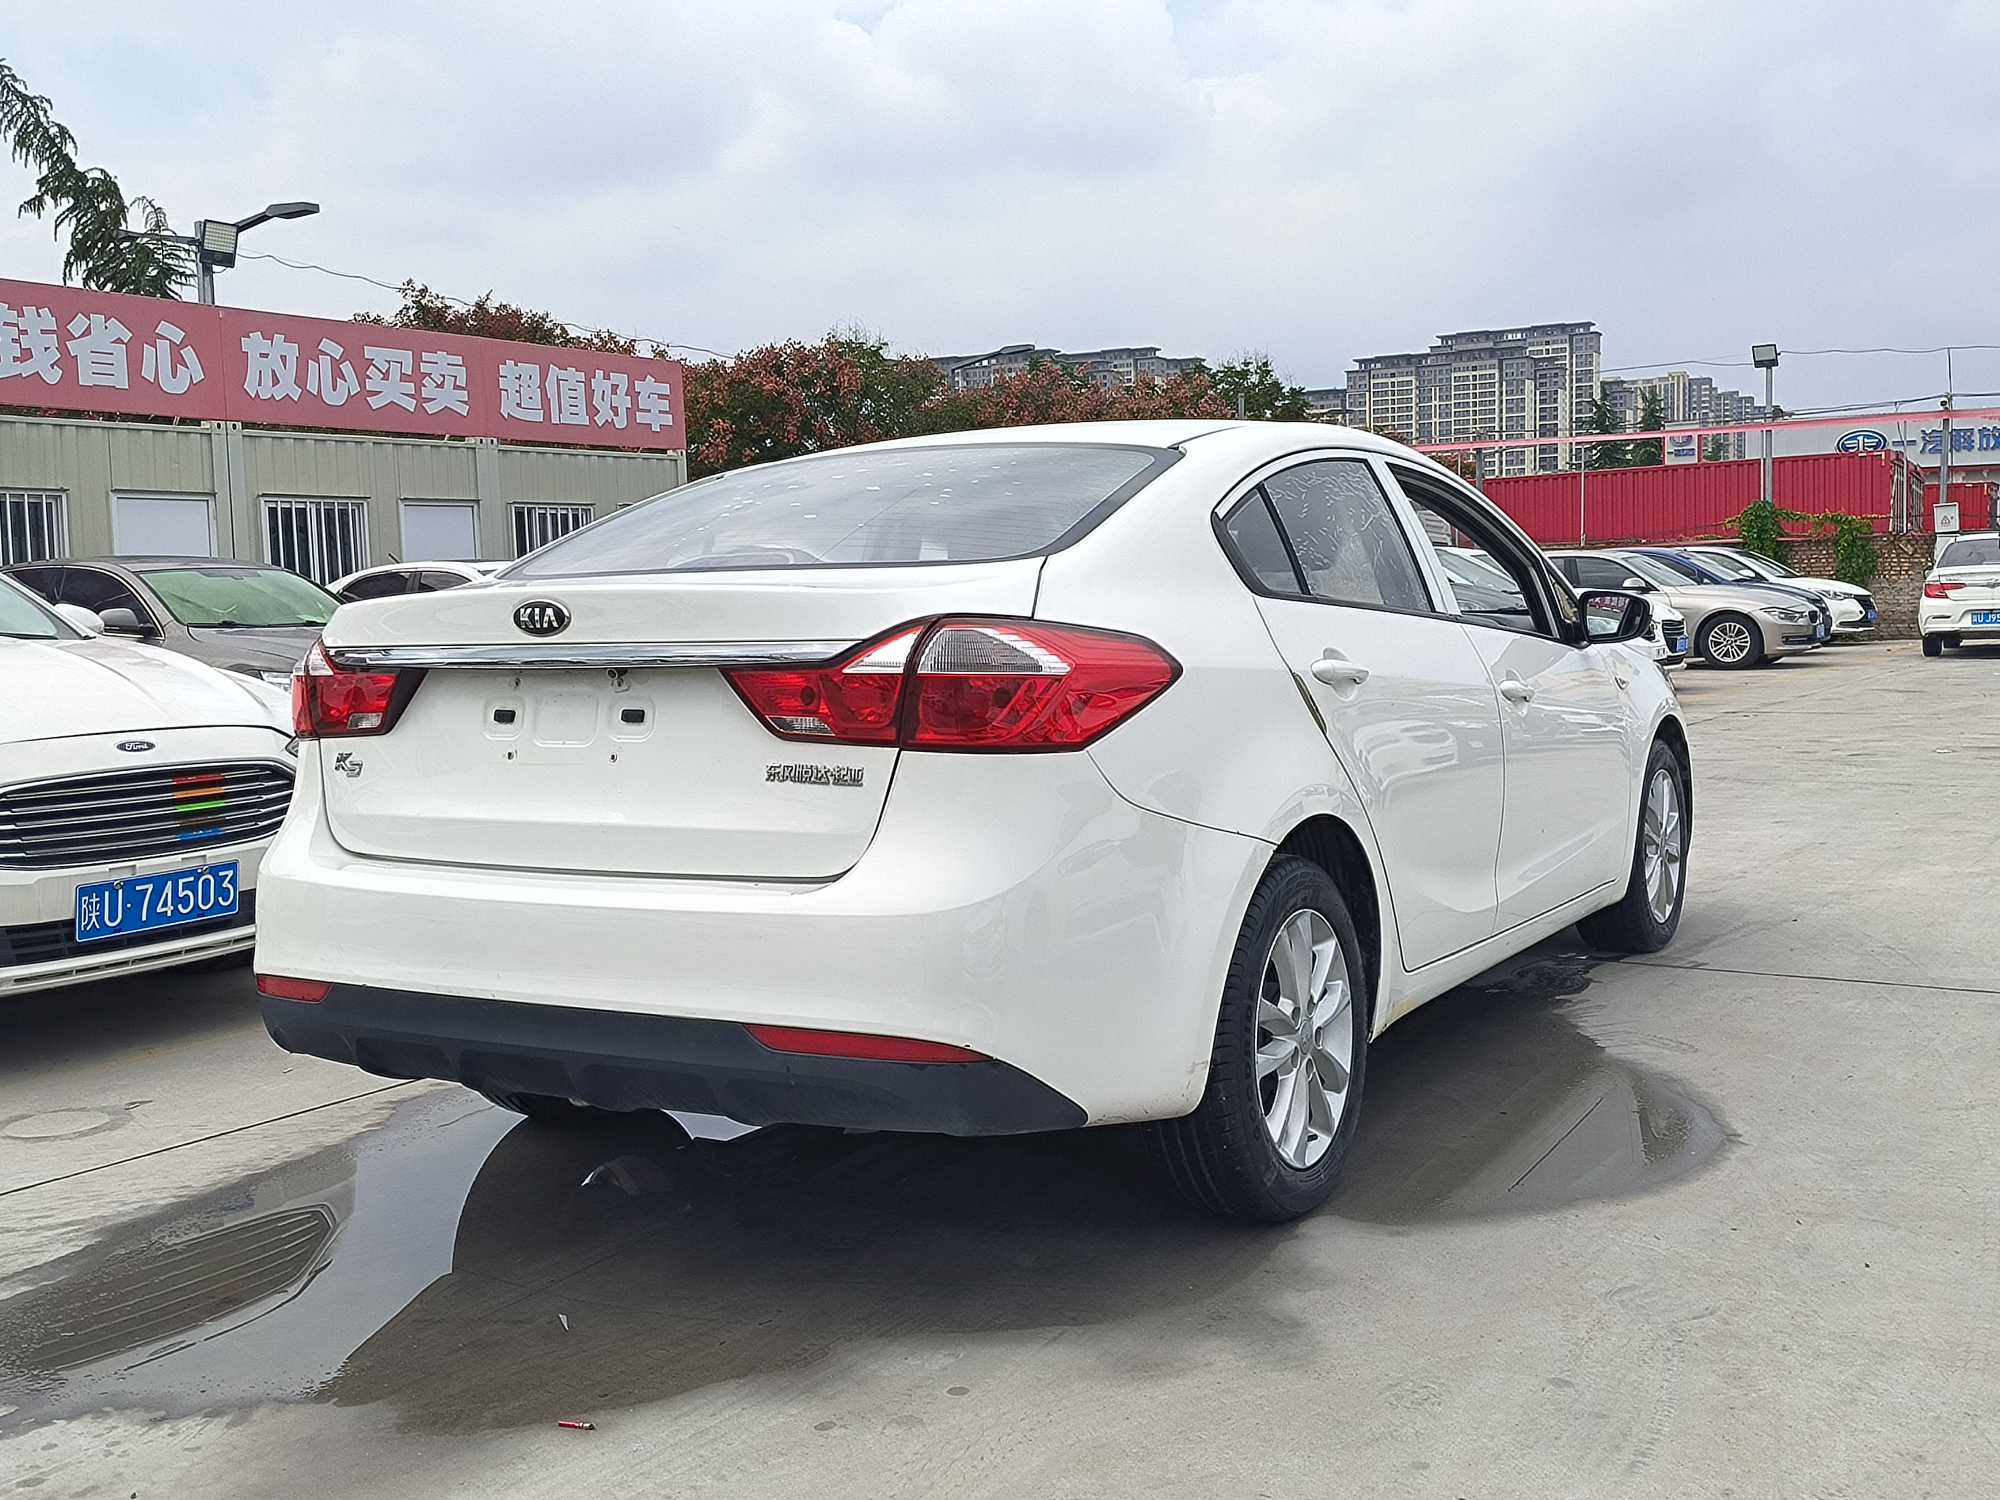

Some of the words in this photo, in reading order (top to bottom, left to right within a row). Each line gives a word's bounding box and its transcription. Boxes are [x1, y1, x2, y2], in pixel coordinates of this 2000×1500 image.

[0, 302, 204, 394] 钱省心
[240, 331, 470, 417] 放心买卖
[498, 359, 673, 432] 超值好车
[519, 607, 559, 629] KIA
